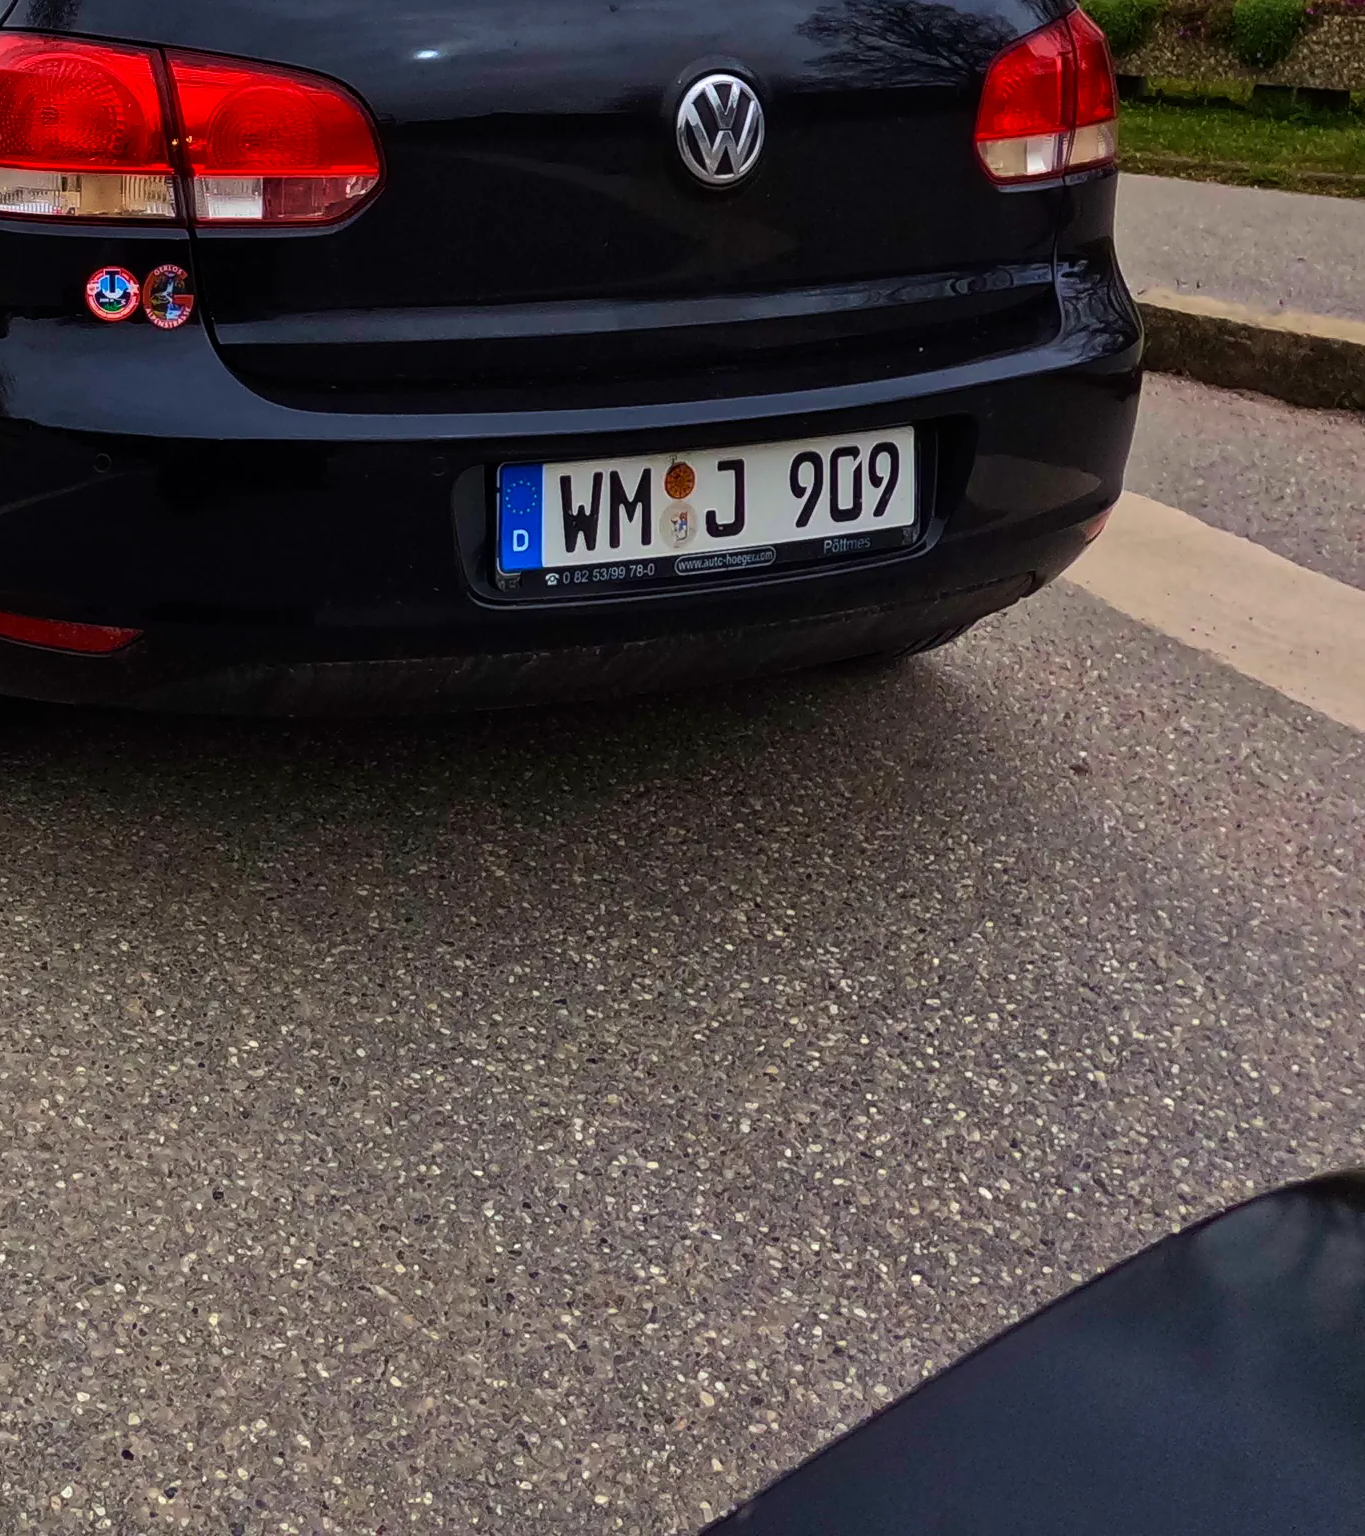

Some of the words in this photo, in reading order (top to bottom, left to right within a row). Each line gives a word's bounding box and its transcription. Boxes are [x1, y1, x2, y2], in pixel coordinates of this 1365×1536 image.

[559, 467, 652, 553] WM
[705, 458, 746, 538] J
[789, 441, 900, 529] 909
[512, 529, 529, 552] D
[823, 536, 871, 554] Pöttmes
[562, 571, 570, 584] 0
[573, 570, 589, 583] 82
[592, 566, 626, 581] 53/99
[629, 563, 656, 577] 78-0
